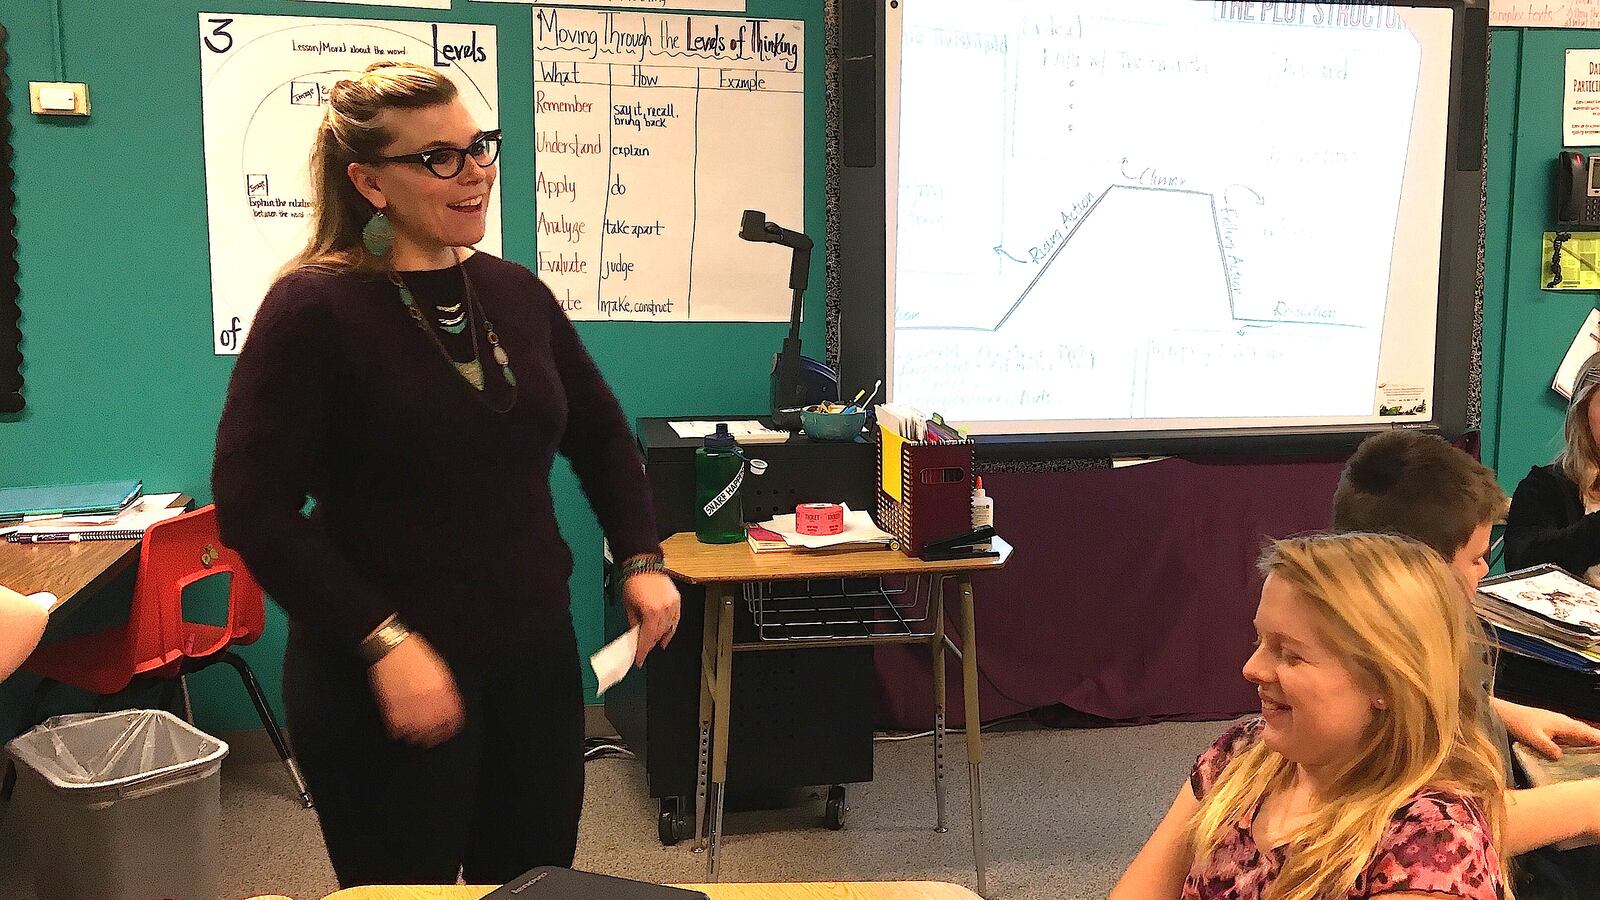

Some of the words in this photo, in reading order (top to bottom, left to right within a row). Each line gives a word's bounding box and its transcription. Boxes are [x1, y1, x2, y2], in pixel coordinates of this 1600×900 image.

[203, 18, 234, 54] 3
[292, 39, 347, 56] Lesson/Moral
[350, 45, 371, 54] about
[374, 45, 385, 55] the
[431, 24, 488, 67] Levels
[537, 8, 598, 60] Moving
[598, 12, 652, 62] Through
[660, 20, 680, 50] the
[686, 17, 726, 57] Levels
[730, 25, 746, 60] of
[746, 19, 799, 71] Thinking
[540, 61, 581, 86] What
[632, 65, 659, 87] How
[719, 69, 766, 92] Example
[536, 90, 595, 114] Remember
[612, 104, 633, 121] say
[613, 115, 642, 132] bring
[644, 117, 668, 129] back
[536, 130, 602, 158] Understand
[612, 143, 650, 158] explain
[537, 171, 577, 203] Apply
[610, 173, 627, 196] do
[249, 196, 275, 208] Explain
[275, 198, 287, 207] the
[537, 211, 586, 244] Analyze
[603, 219, 630, 236] take
[631, 219, 665, 239] apart
[1028, 228, 1065, 265] Rising
[1060, 192, 1095, 230] Action
[538, 250, 588, 274] Evaluate
[602, 252, 635, 281] judge
[633, 295, 674, 317] construct
[219, 316, 243, 351] of
